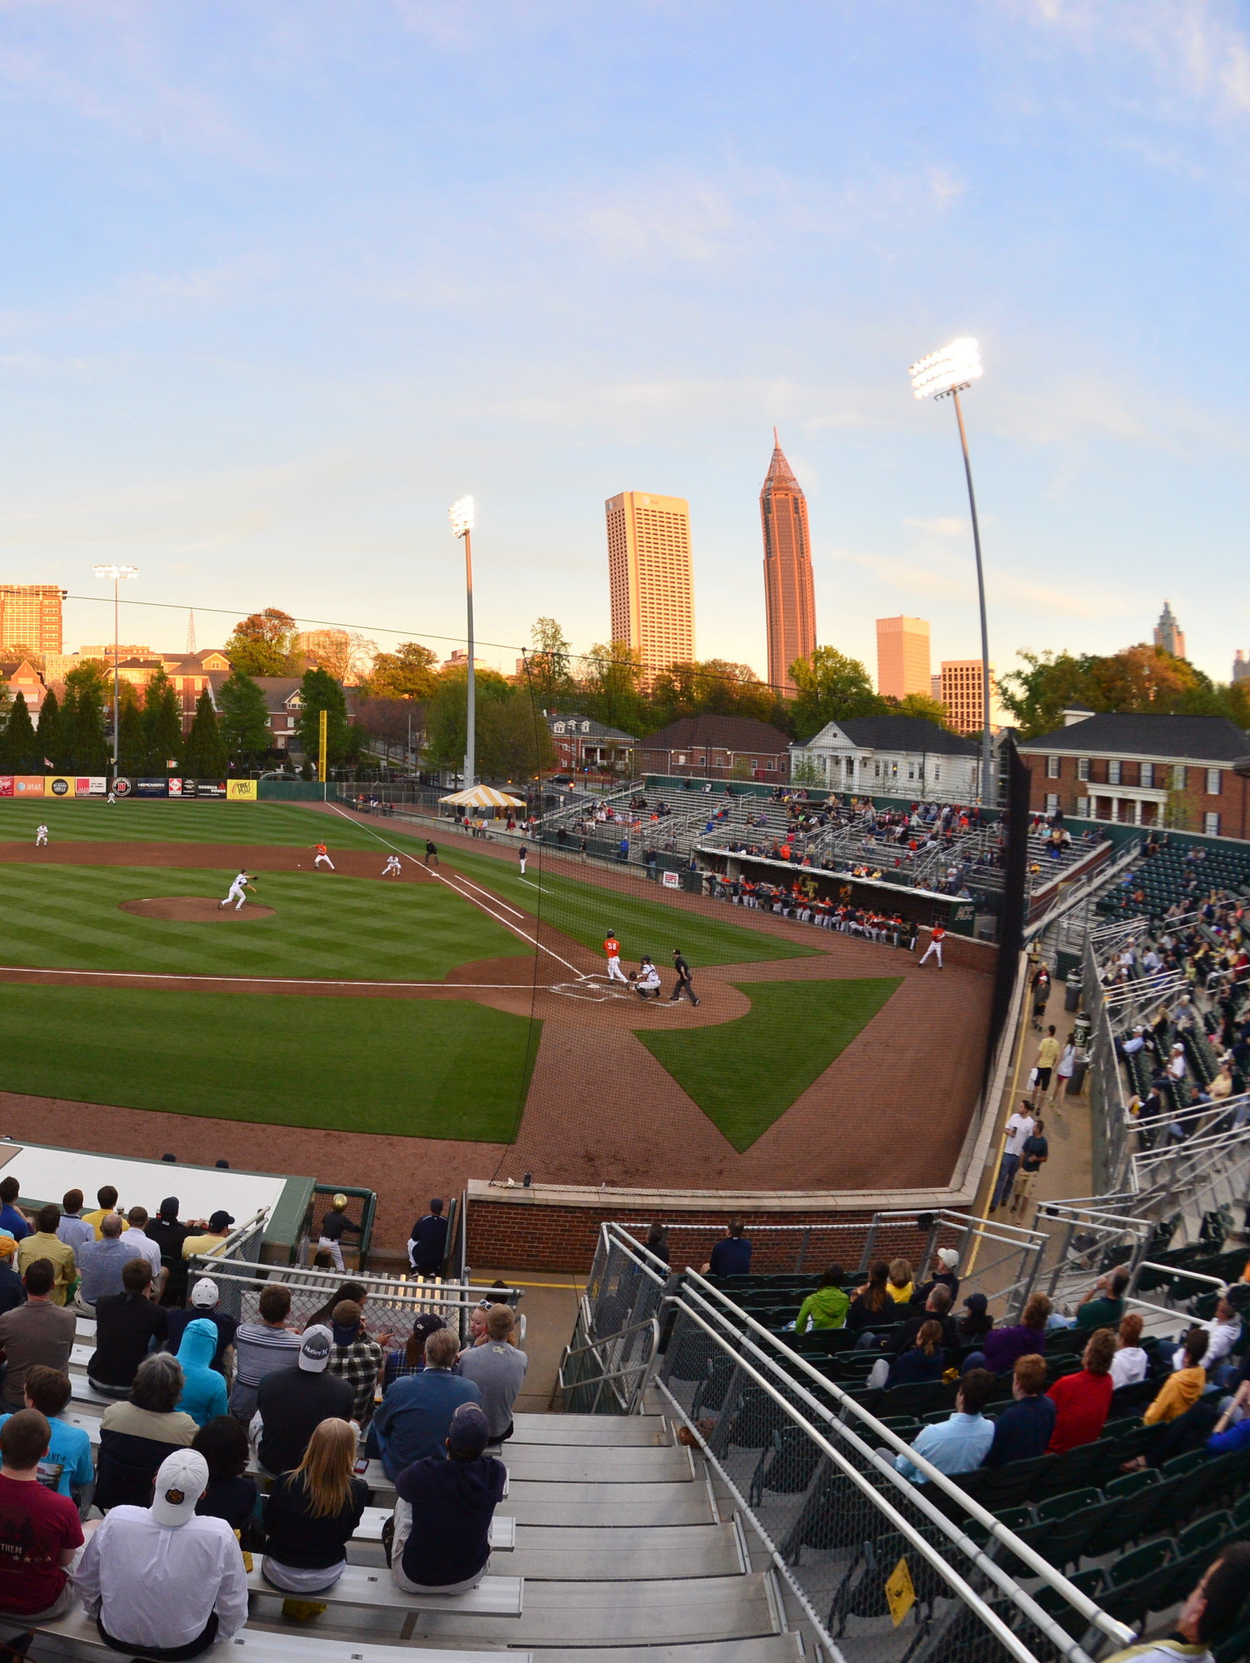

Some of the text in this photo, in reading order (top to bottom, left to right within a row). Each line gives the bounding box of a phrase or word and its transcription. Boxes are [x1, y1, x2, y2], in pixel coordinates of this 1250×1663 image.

[954, 905, 975, 921] ACC
[607, 942, 617, 950] 38
[304, 1345, 322, 1356] Hurley
[0, 1543, 23, 1555] THEM
